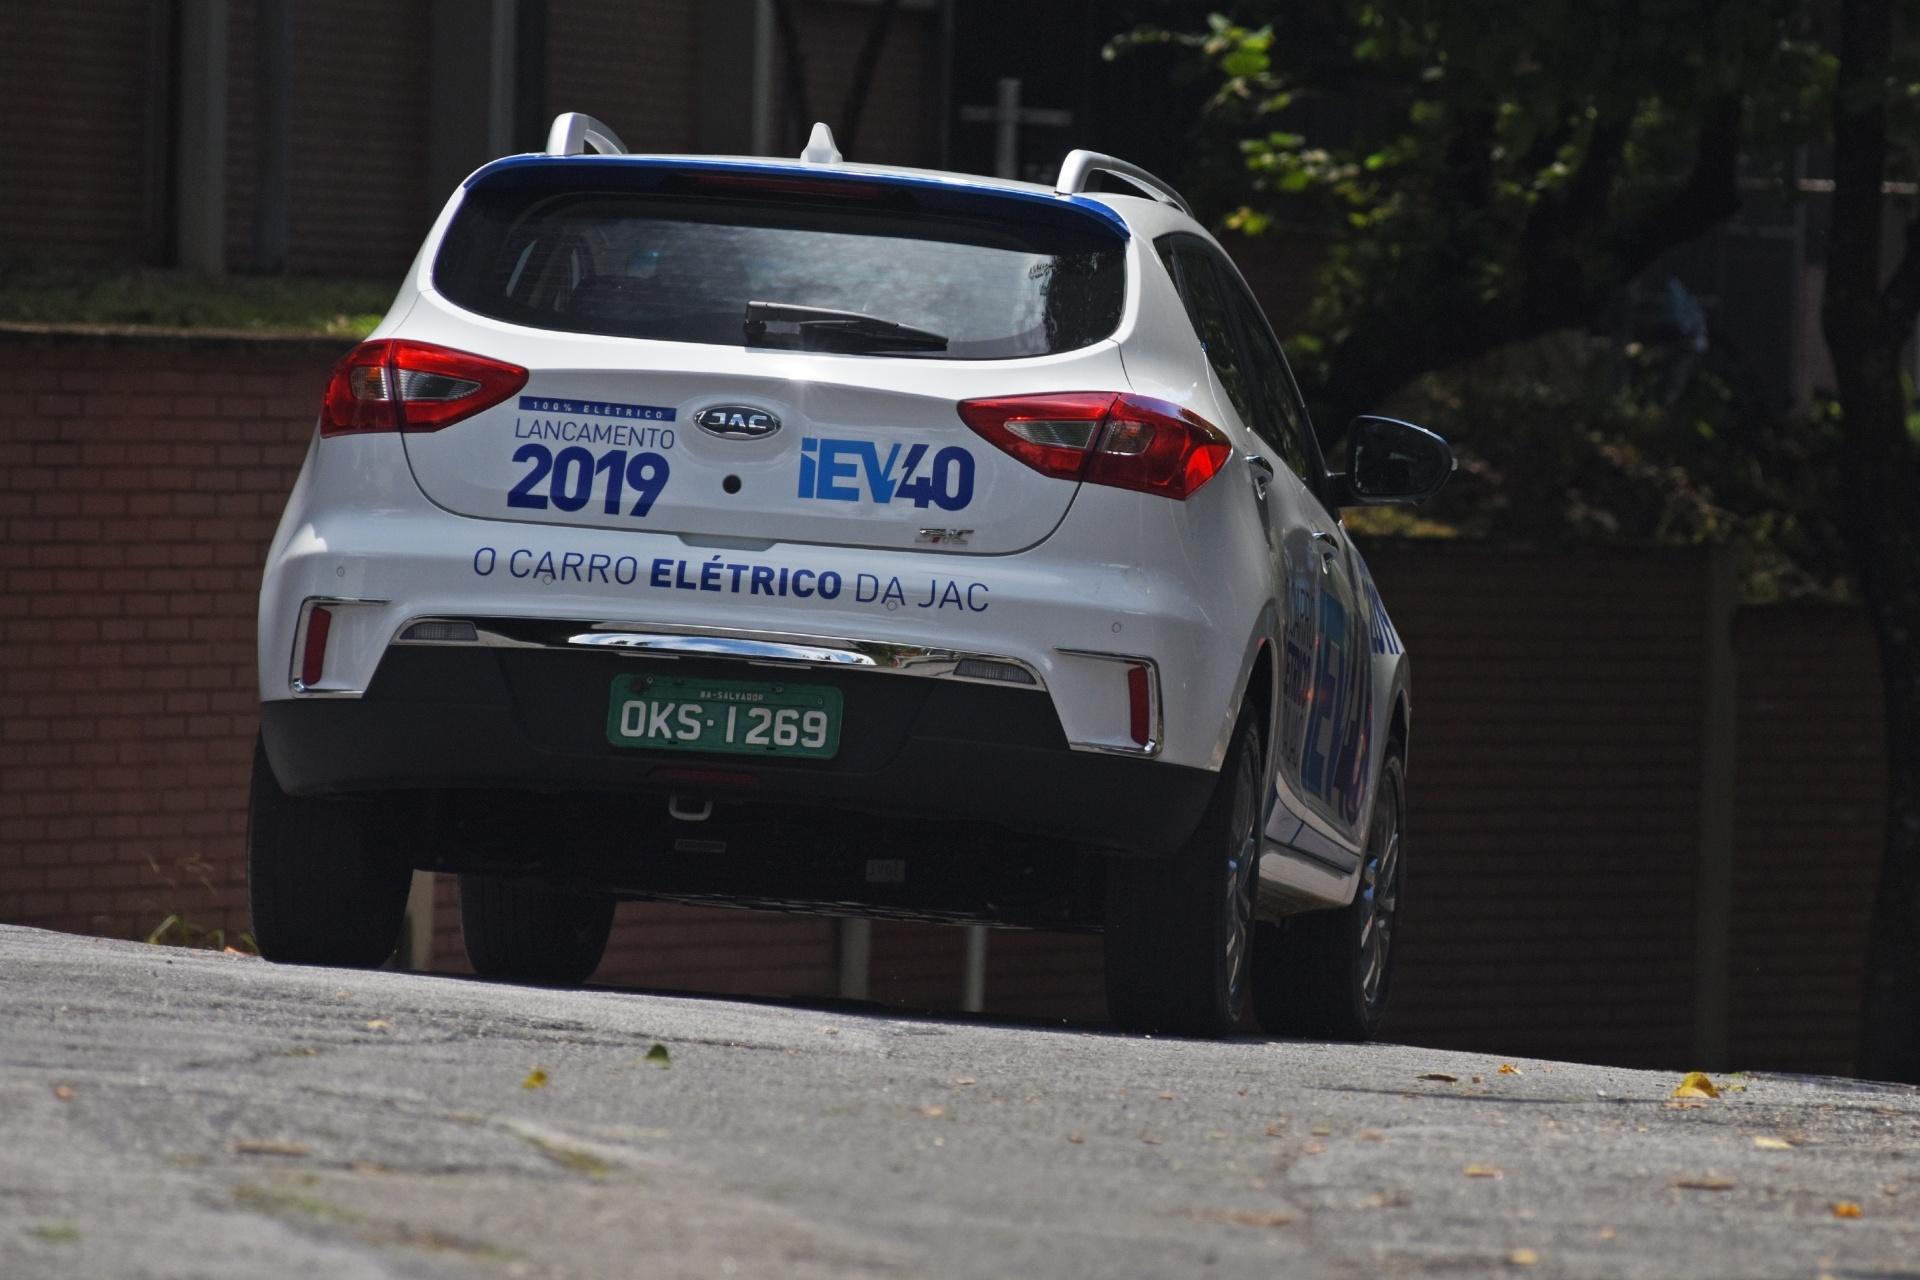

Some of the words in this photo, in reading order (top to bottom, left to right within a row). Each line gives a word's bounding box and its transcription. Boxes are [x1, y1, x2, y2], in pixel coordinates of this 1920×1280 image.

[532, 401, 573, 413] 100%
[583, 402, 663, 419] ELÉTRICO
[708, 411, 768, 429] JAC
[515, 418, 675, 450] LANCAMENTO
[507, 443, 670, 517] 2019
[473, 547, 496, 576] O
[509, 549, 638, 585] CARRO
[650, 555, 842, 600] ELÉTRICO
[856, 573, 905, 606] DA
[918, 580, 989, 612] JAC
